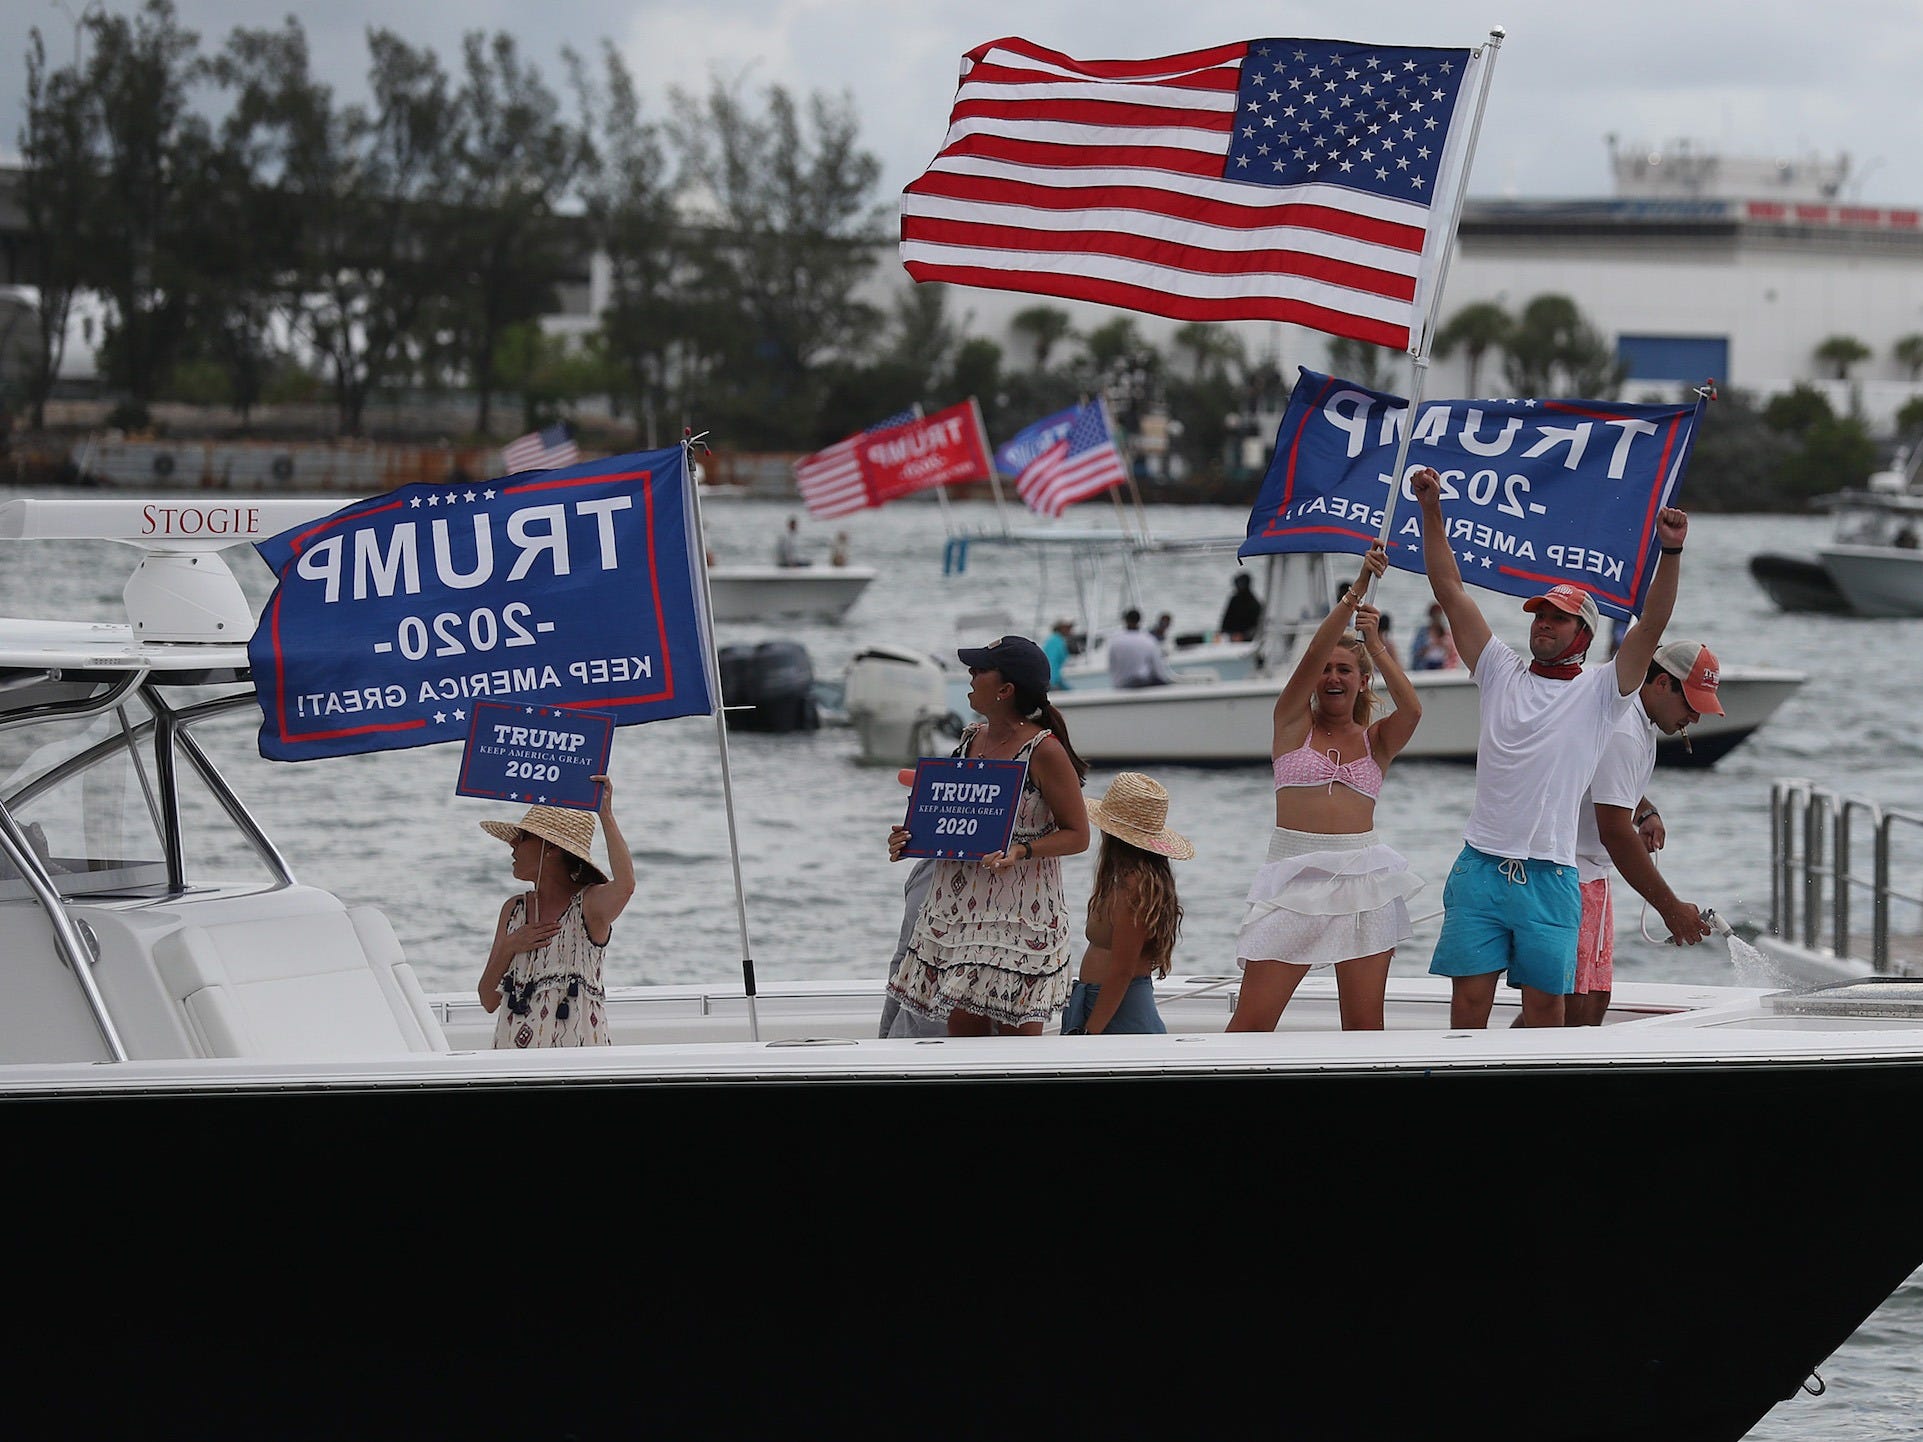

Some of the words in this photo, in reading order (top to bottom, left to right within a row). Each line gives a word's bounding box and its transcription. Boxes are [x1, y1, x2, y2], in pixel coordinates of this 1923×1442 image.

[494, 725, 586, 752] TRUMP
[480, 745, 507, 756] KEEP
[508, 749, 556, 761] AMERICA
[559, 755, 593, 766] GREAT
[505, 760, 561, 782] 2020
[931, 782, 1001, 803] TRUMP
[918, 804, 939, 813] KEEP
[940, 805, 976, 814] AMERICA
[978, 807, 1005, 816] GREAT
[935, 817, 978, 836] 2020
